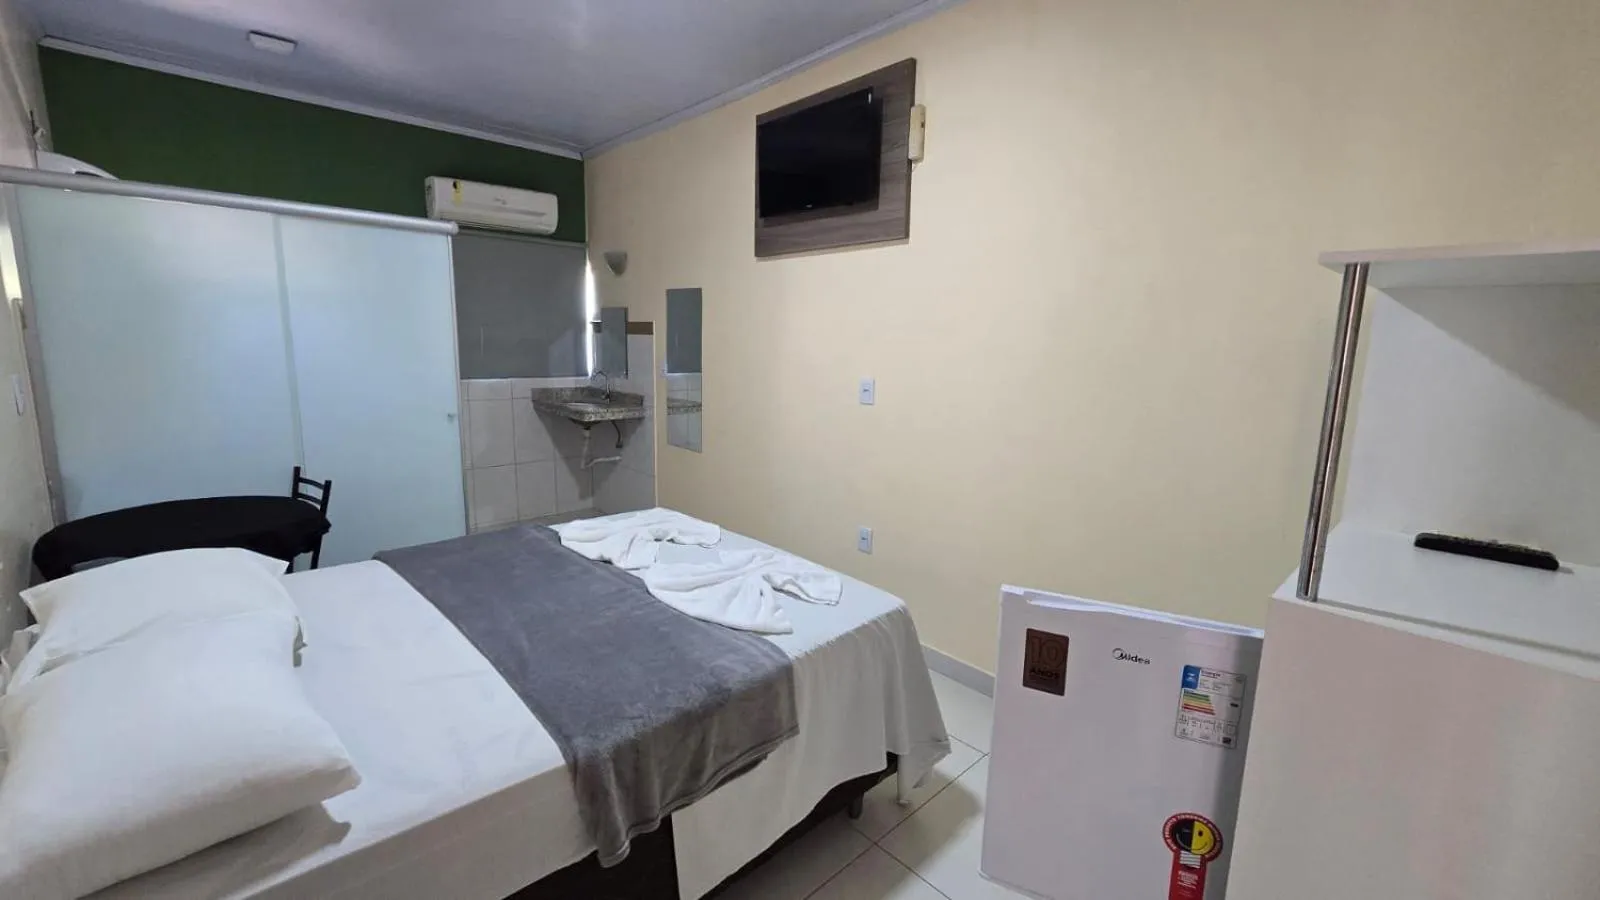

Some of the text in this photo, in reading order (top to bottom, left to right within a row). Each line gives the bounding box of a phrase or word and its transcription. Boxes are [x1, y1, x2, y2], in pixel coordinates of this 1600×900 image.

[1030, 636, 1063, 668] 10
[1112, 647, 1151, 665] Midea
[1029, 667, 1061, 680] ANOS
